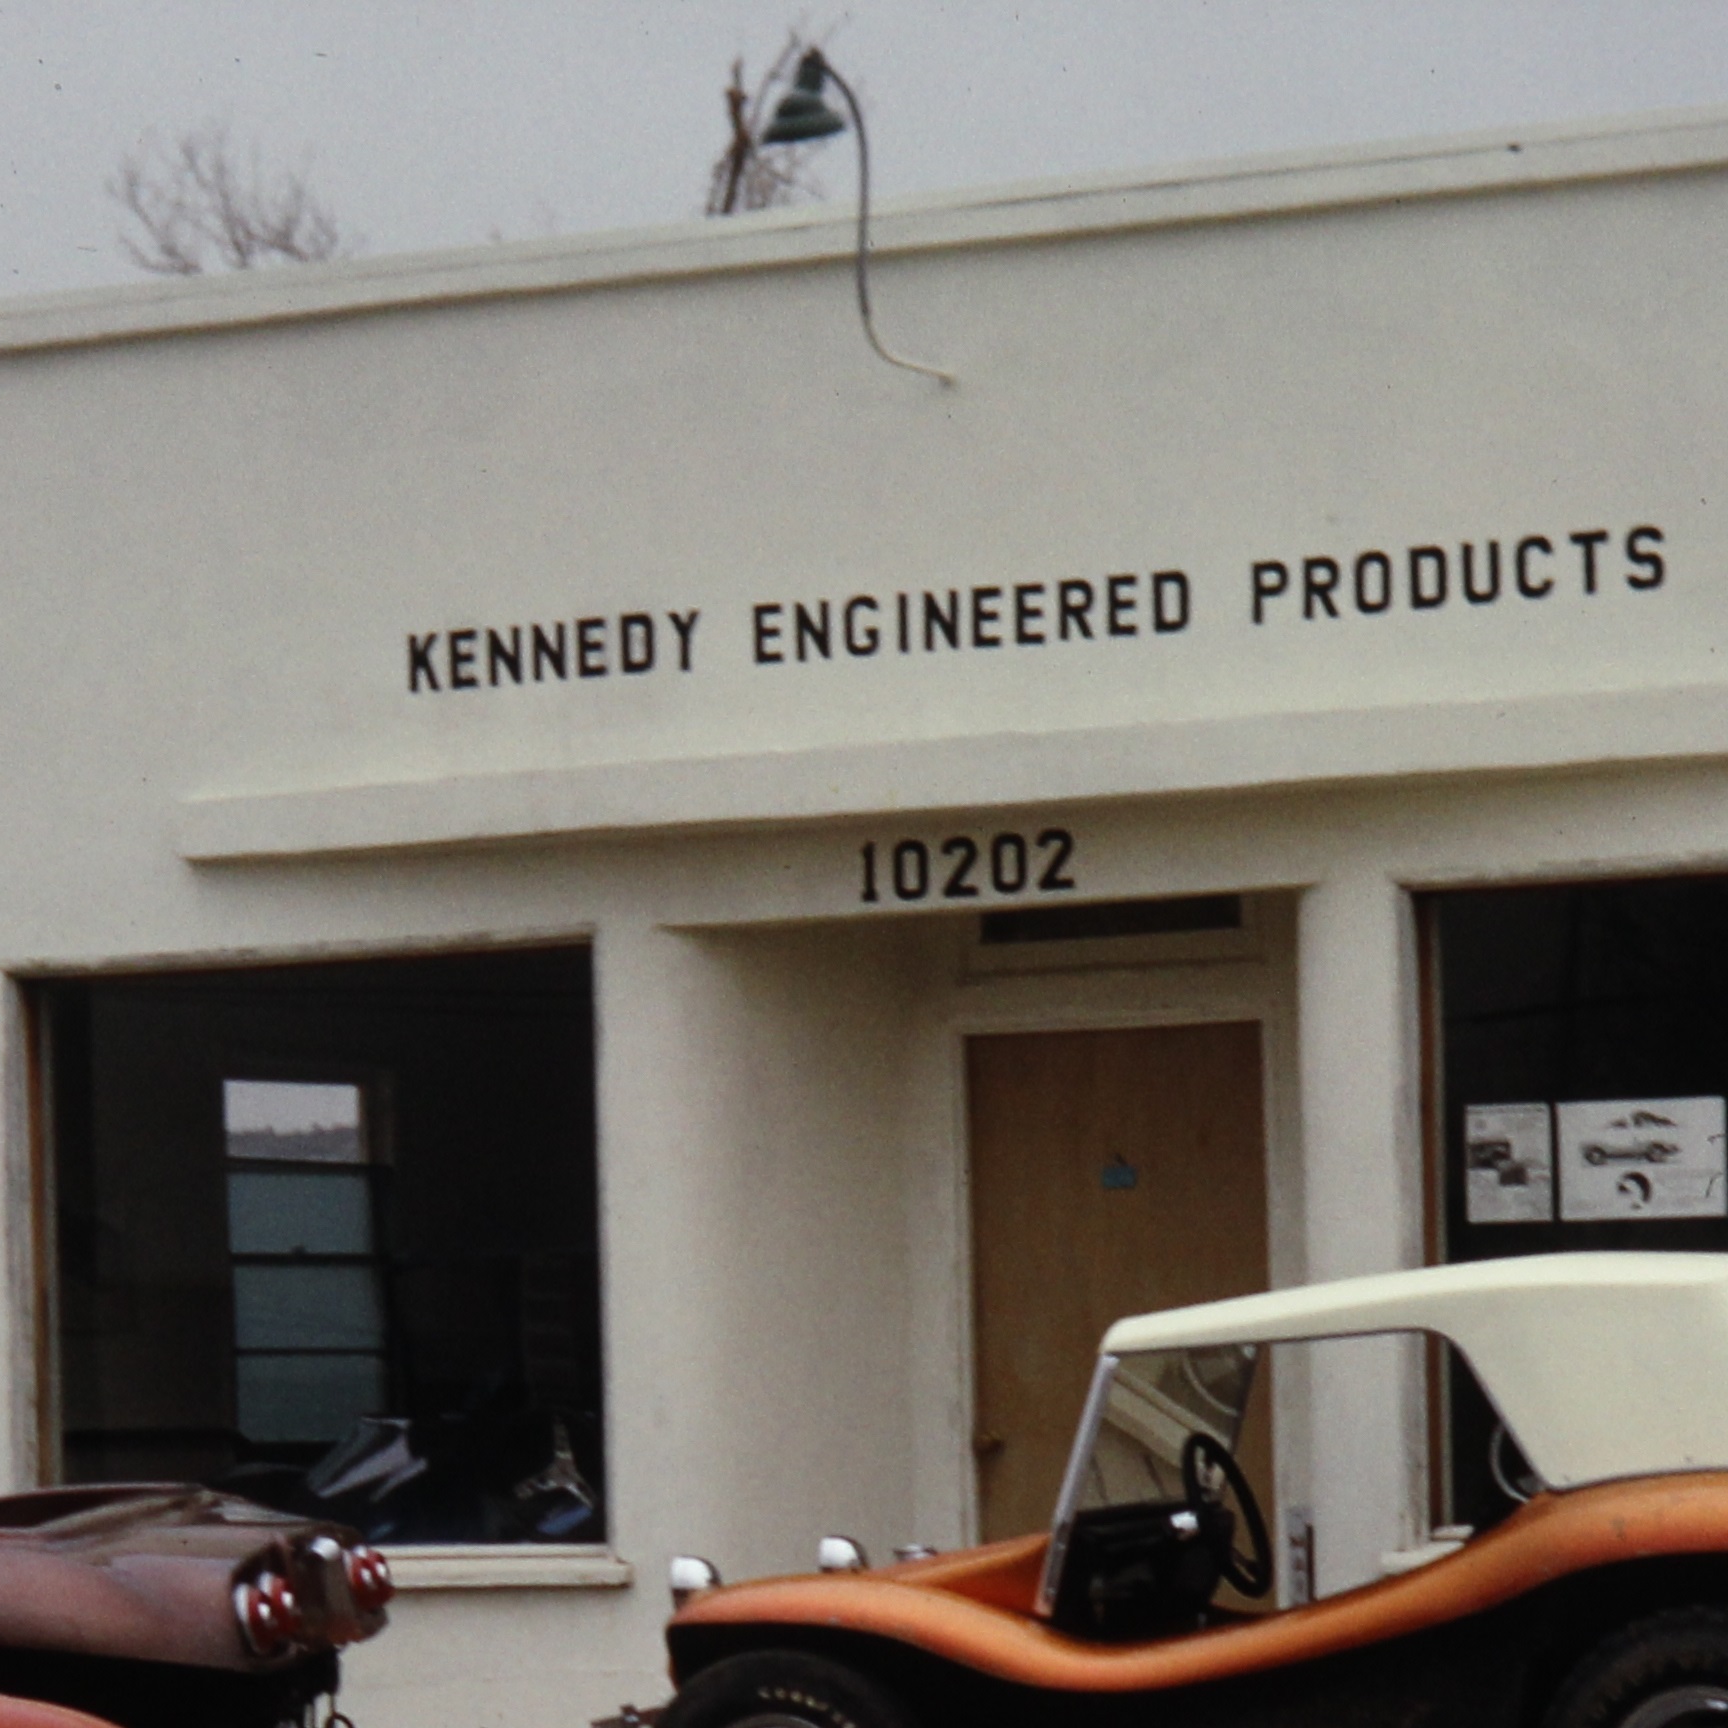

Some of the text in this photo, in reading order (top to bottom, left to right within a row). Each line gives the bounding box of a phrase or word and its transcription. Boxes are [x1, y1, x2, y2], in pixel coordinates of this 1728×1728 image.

[406, 525, 1666, 694] KENNEDY ENGINEERED PRODUCTS
[860, 827, 1076, 903] 10202
